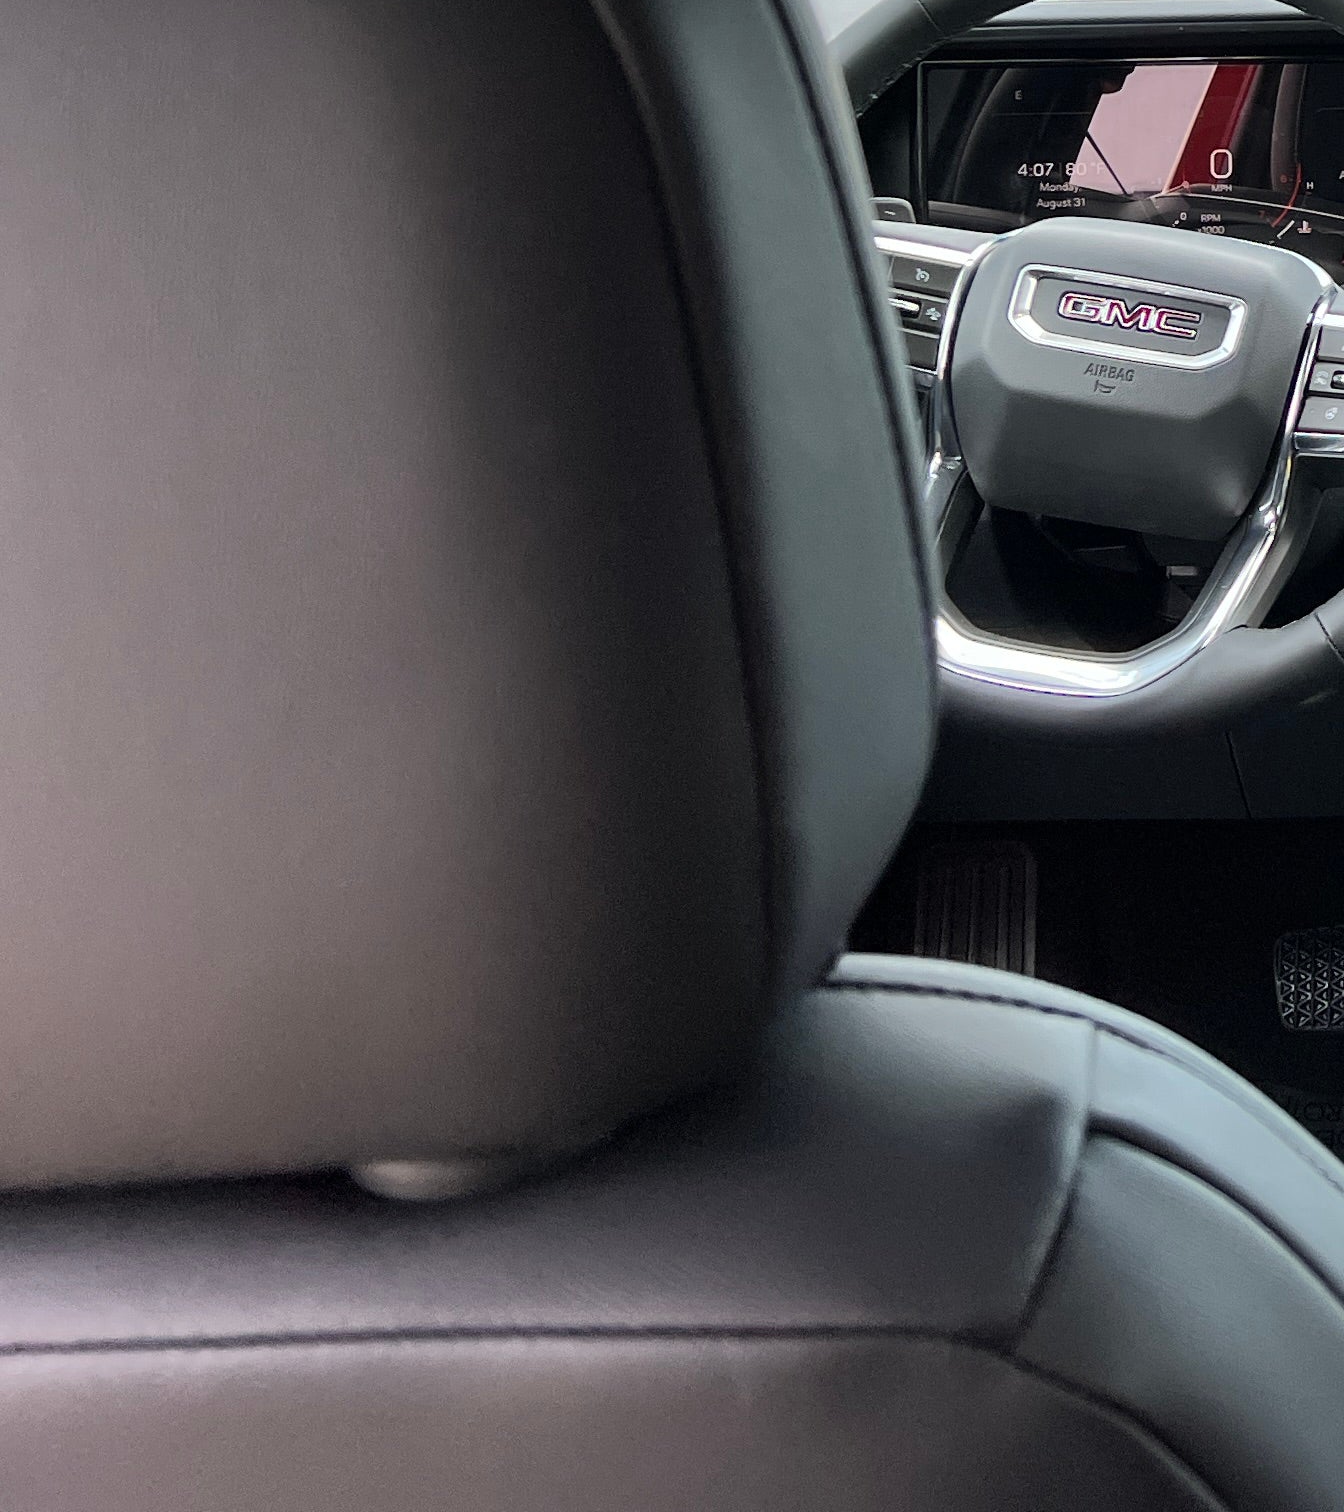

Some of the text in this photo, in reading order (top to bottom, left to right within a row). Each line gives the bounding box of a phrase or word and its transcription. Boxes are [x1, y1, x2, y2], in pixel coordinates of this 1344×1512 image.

[1017, 162, 1054, 177] 4:07
[1065, 162, 1087, 177] 80
[1209, 148, 1233, 179] 0
[1211, 184, 1233, 192] MPH
[1306, 181, 1314, 190] H
[1036, 197, 1086, 211] August 31
[1200, 214, 1221, 223] RPM
[1058, 292, 1202, 339] GMC
[1083, 363, 1135, 382] AIRBAG
